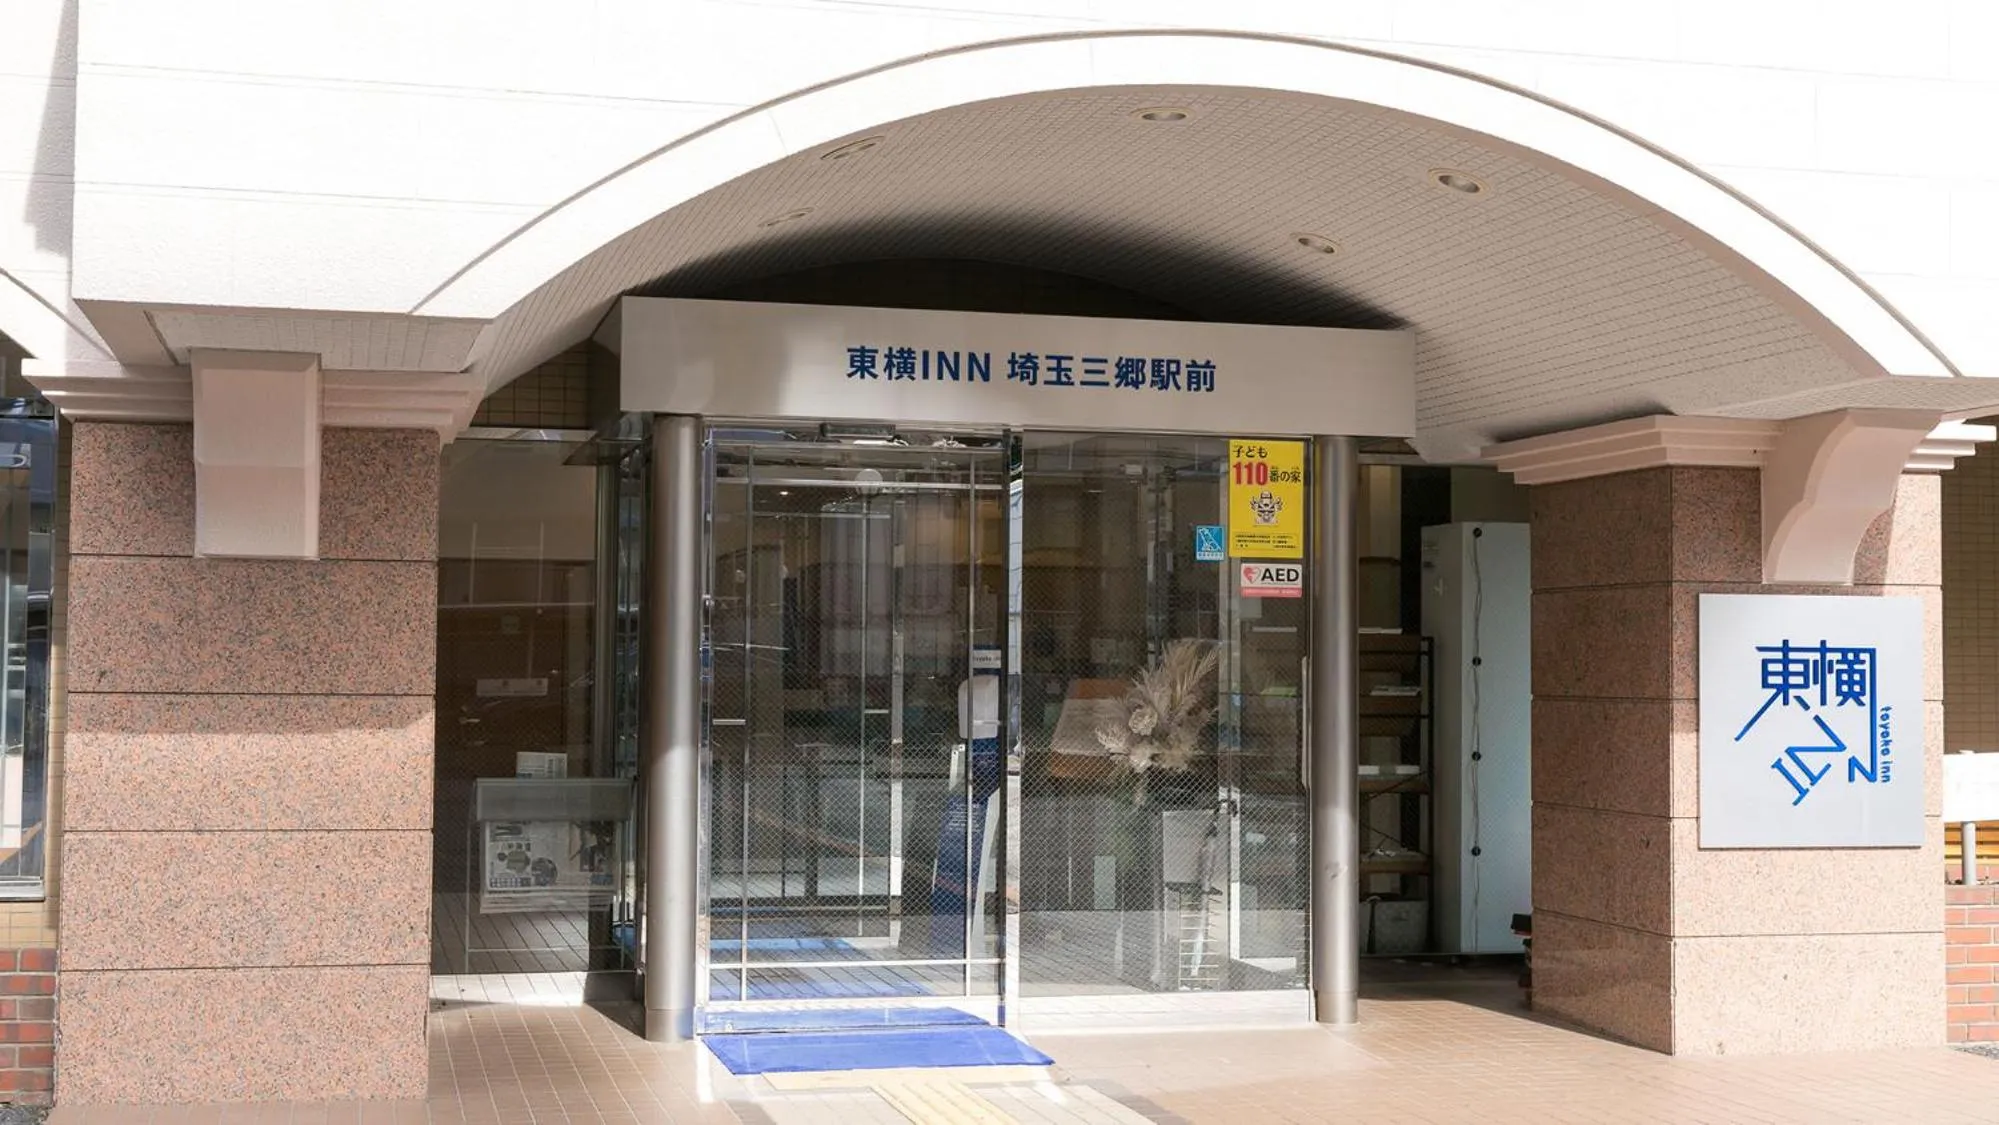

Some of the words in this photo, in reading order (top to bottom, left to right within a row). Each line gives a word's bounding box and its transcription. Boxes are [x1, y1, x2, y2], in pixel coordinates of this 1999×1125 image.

[846, 346, 992, 382] 東横INN
[1007, 352, 1217, 392] 埼玉三郷駅前
[1232, 445, 1268, 458] 子ども
[1260, 567, 1300, 582] AED
[1879, 705, 1893, 757] toyoko
[1880, 759, 1893, 783] inn
